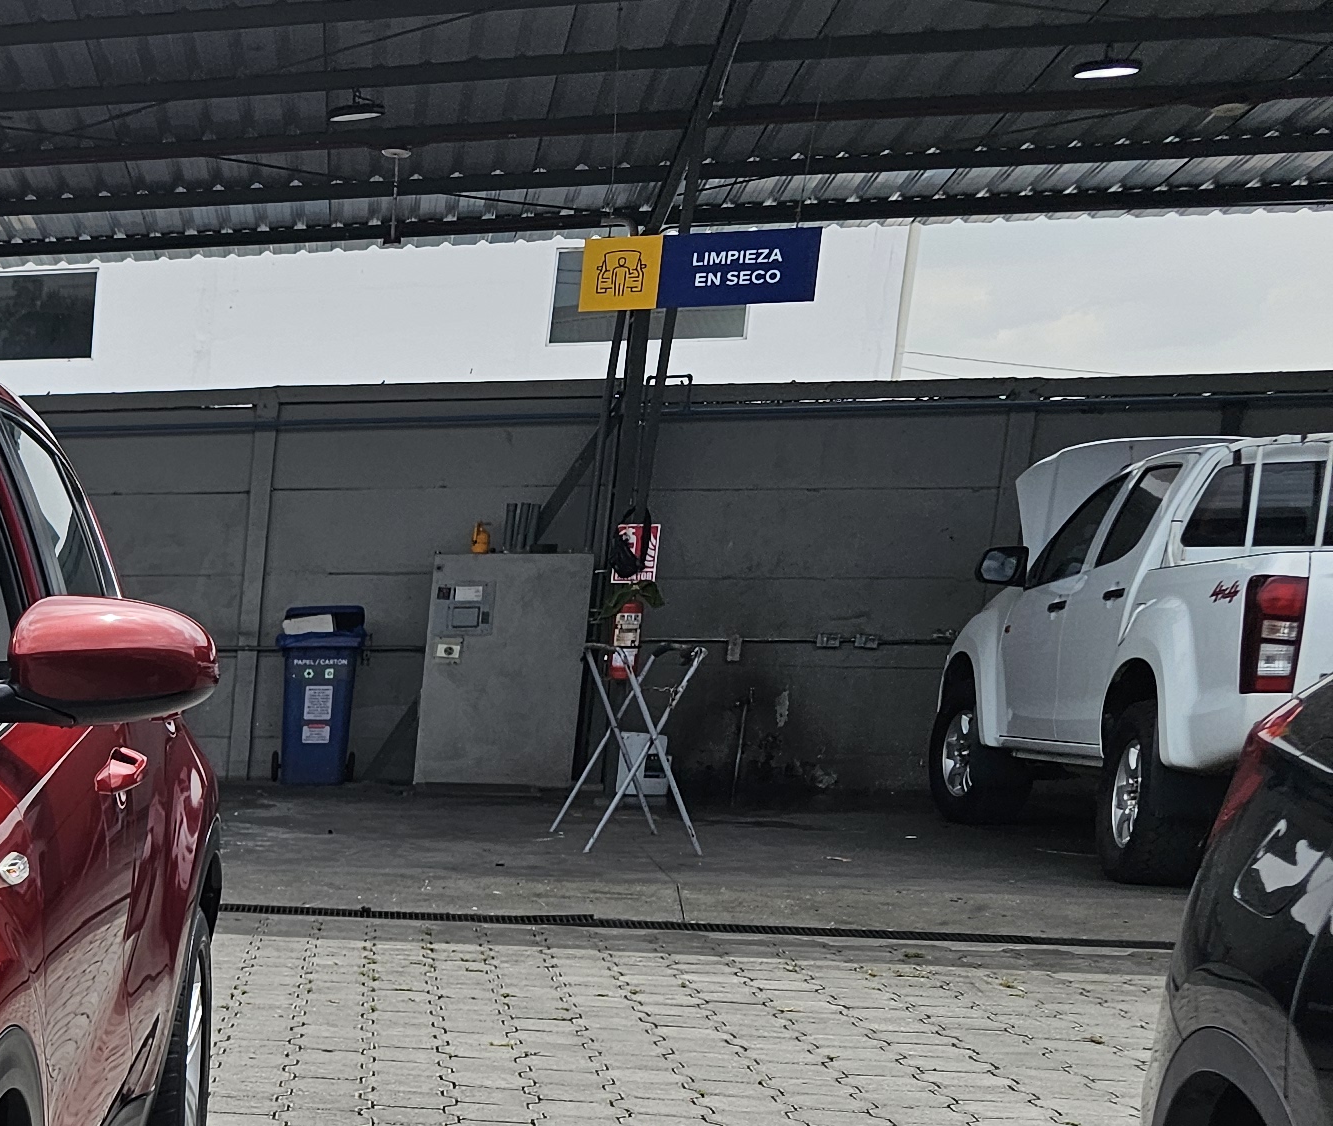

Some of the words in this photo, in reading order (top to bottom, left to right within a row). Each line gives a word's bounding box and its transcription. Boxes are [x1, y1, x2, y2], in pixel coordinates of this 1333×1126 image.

[692, 248, 783, 267] LIMPIEZA
[694, 271, 722, 287] EN
[725, 269, 781, 286] SECO
